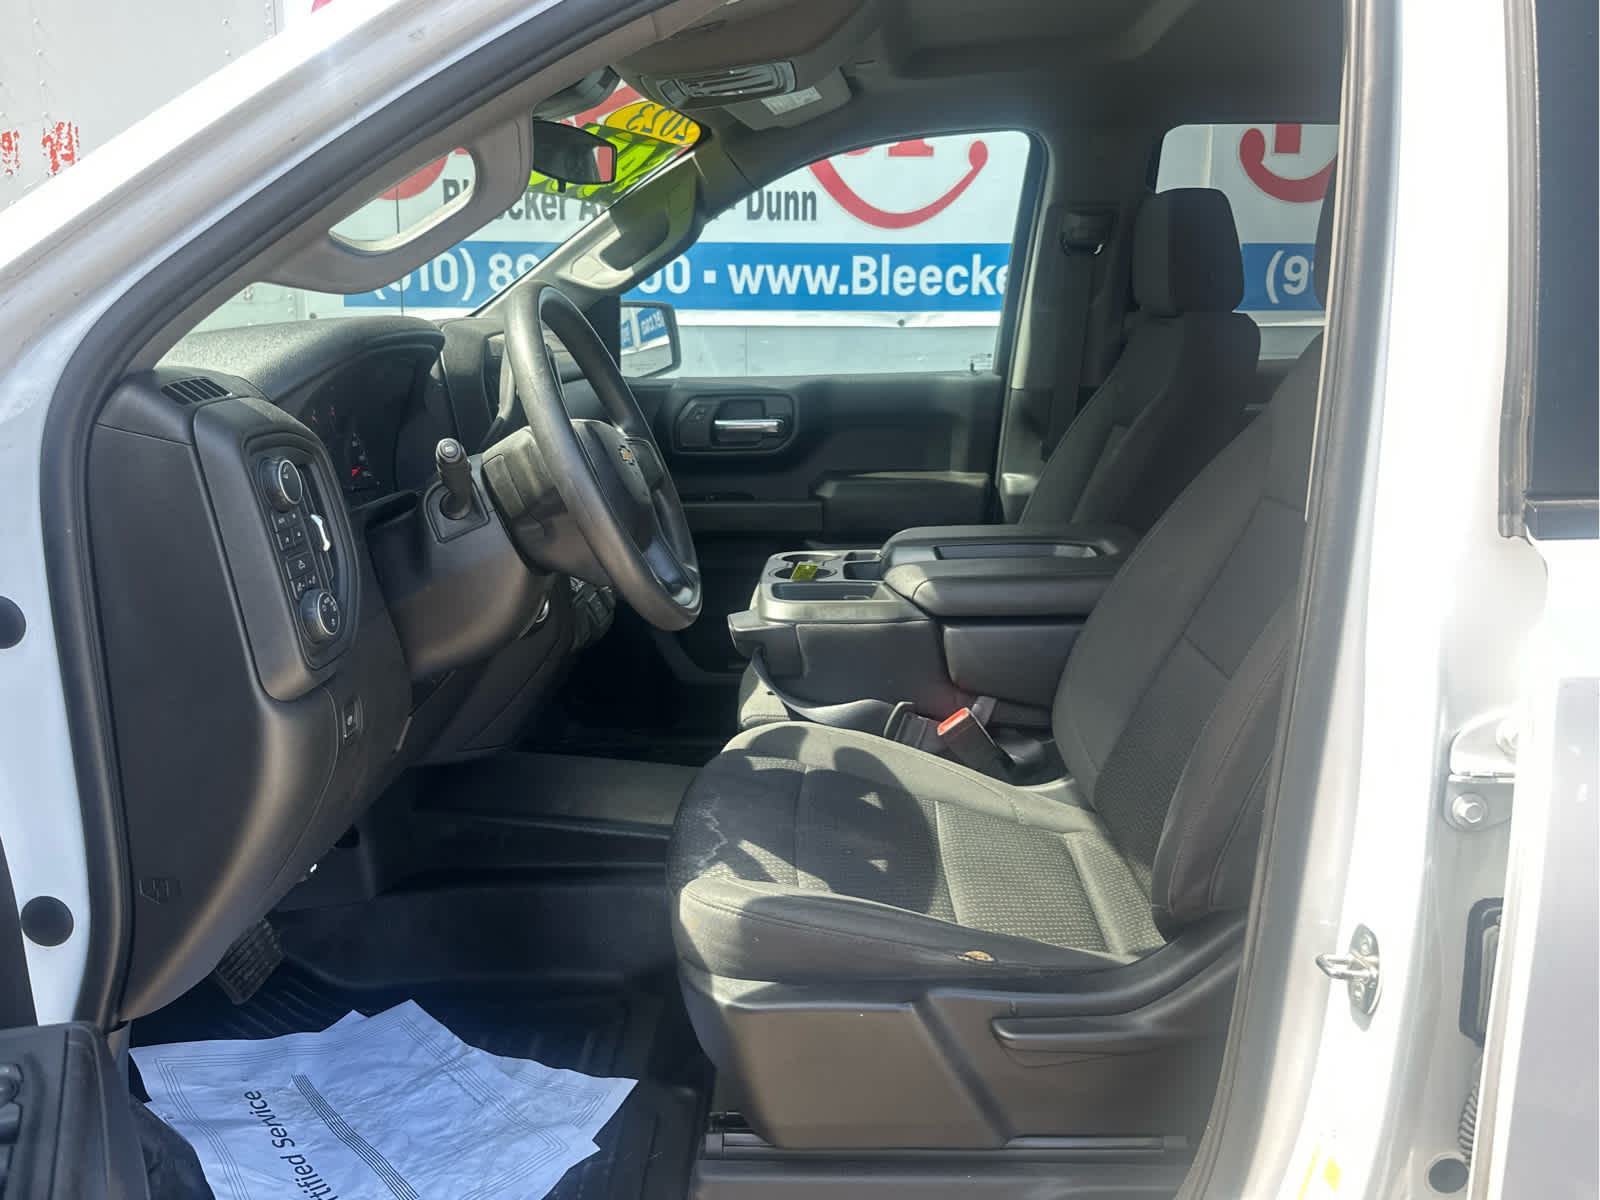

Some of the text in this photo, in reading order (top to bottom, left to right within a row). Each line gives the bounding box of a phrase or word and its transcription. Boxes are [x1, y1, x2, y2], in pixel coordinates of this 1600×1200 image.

[746, 189, 817, 221] Dunn
[374, 248, 476, 302] 10)
[244, 1090, 295, 1148] Service
